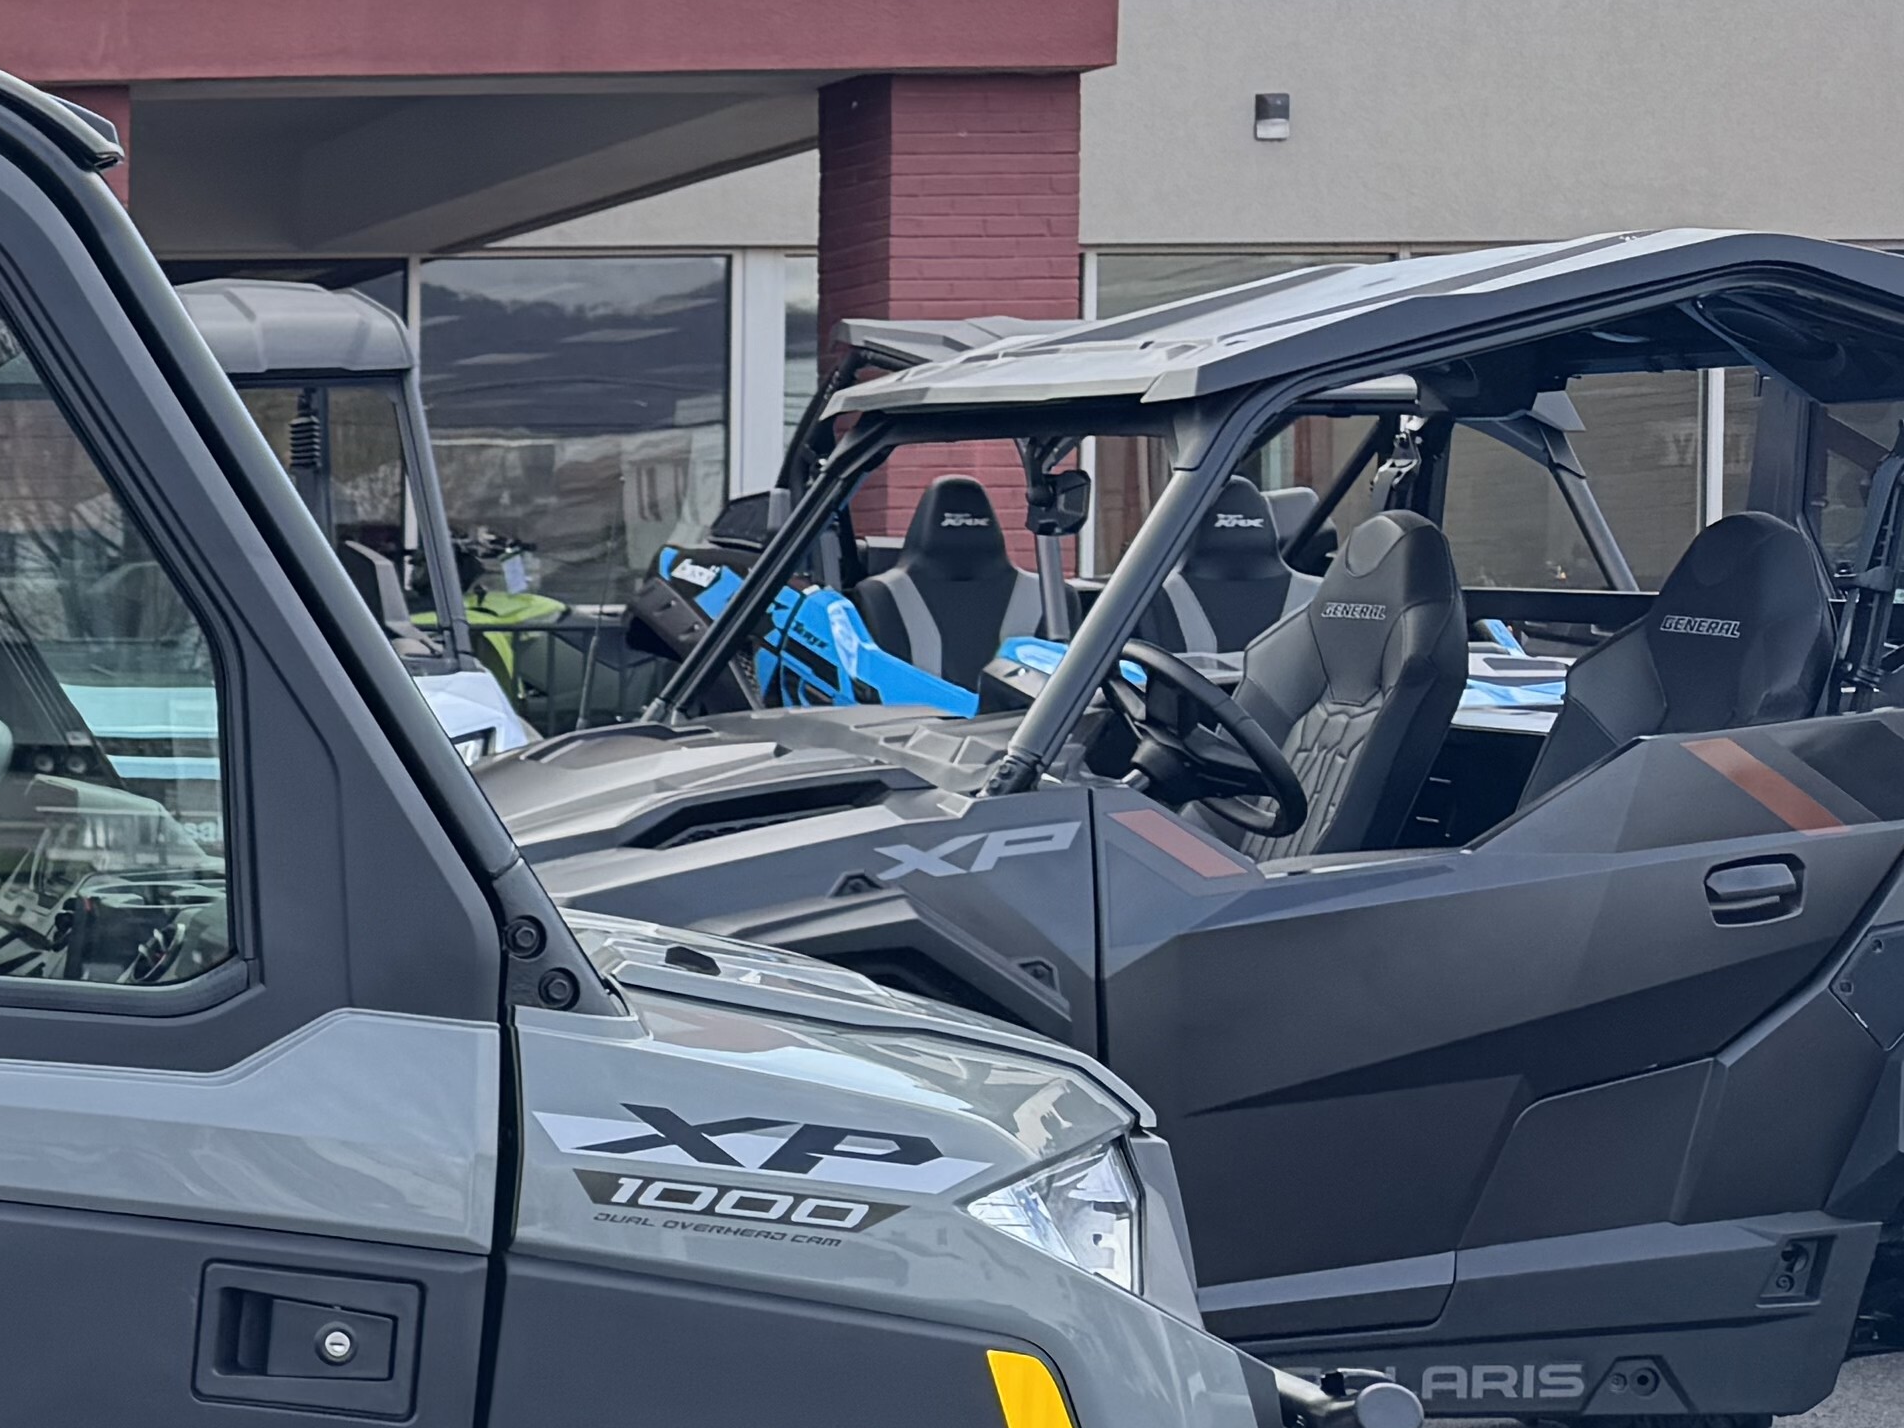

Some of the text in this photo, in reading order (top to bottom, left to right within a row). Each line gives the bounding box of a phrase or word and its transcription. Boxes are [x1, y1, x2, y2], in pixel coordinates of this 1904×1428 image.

[1320, 601, 1387, 621] GENERAL
[1659, 614, 1742, 639] GENERAL
[873, 821, 1083, 881] XP
[573, 1103, 946, 1175] XP
[613, 1176, 871, 1228] 1000
[593, 1212, 843, 1248] DUAL OVERHEAD CAM
